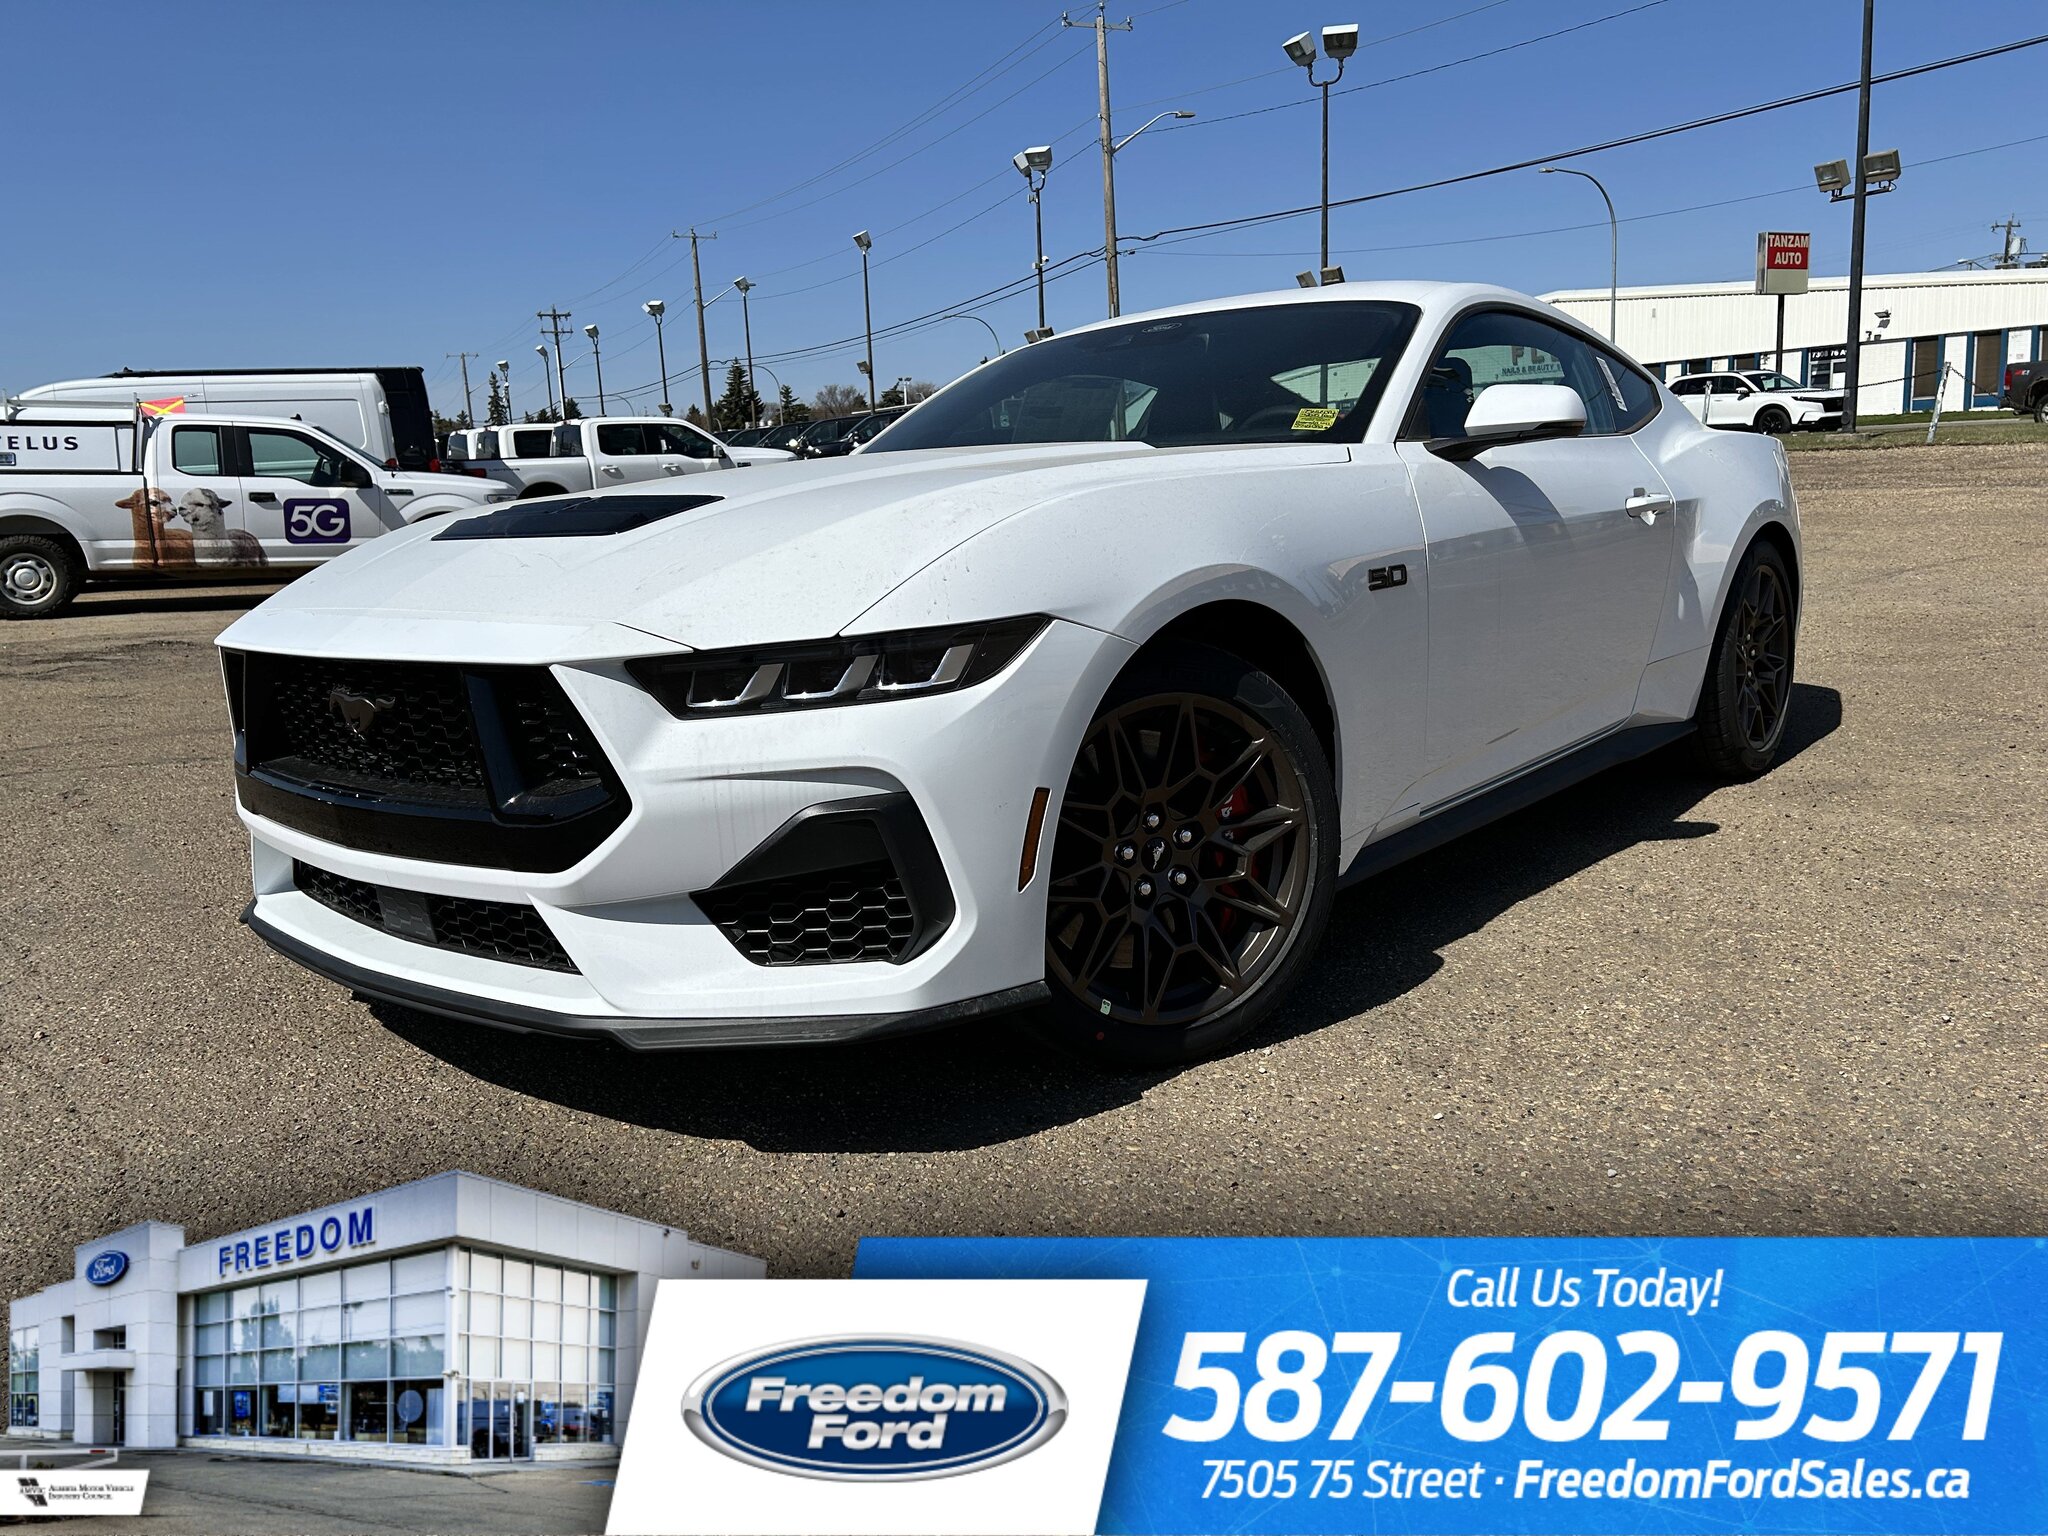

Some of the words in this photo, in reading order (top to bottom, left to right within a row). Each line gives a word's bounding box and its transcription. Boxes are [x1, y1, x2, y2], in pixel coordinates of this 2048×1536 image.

[1768, 234, 1809, 248] TANZAM
[1774, 252, 1802, 265] AUTO
[0, 436, 79, 451] ELUS
[290, 504, 346, 537] 5G
